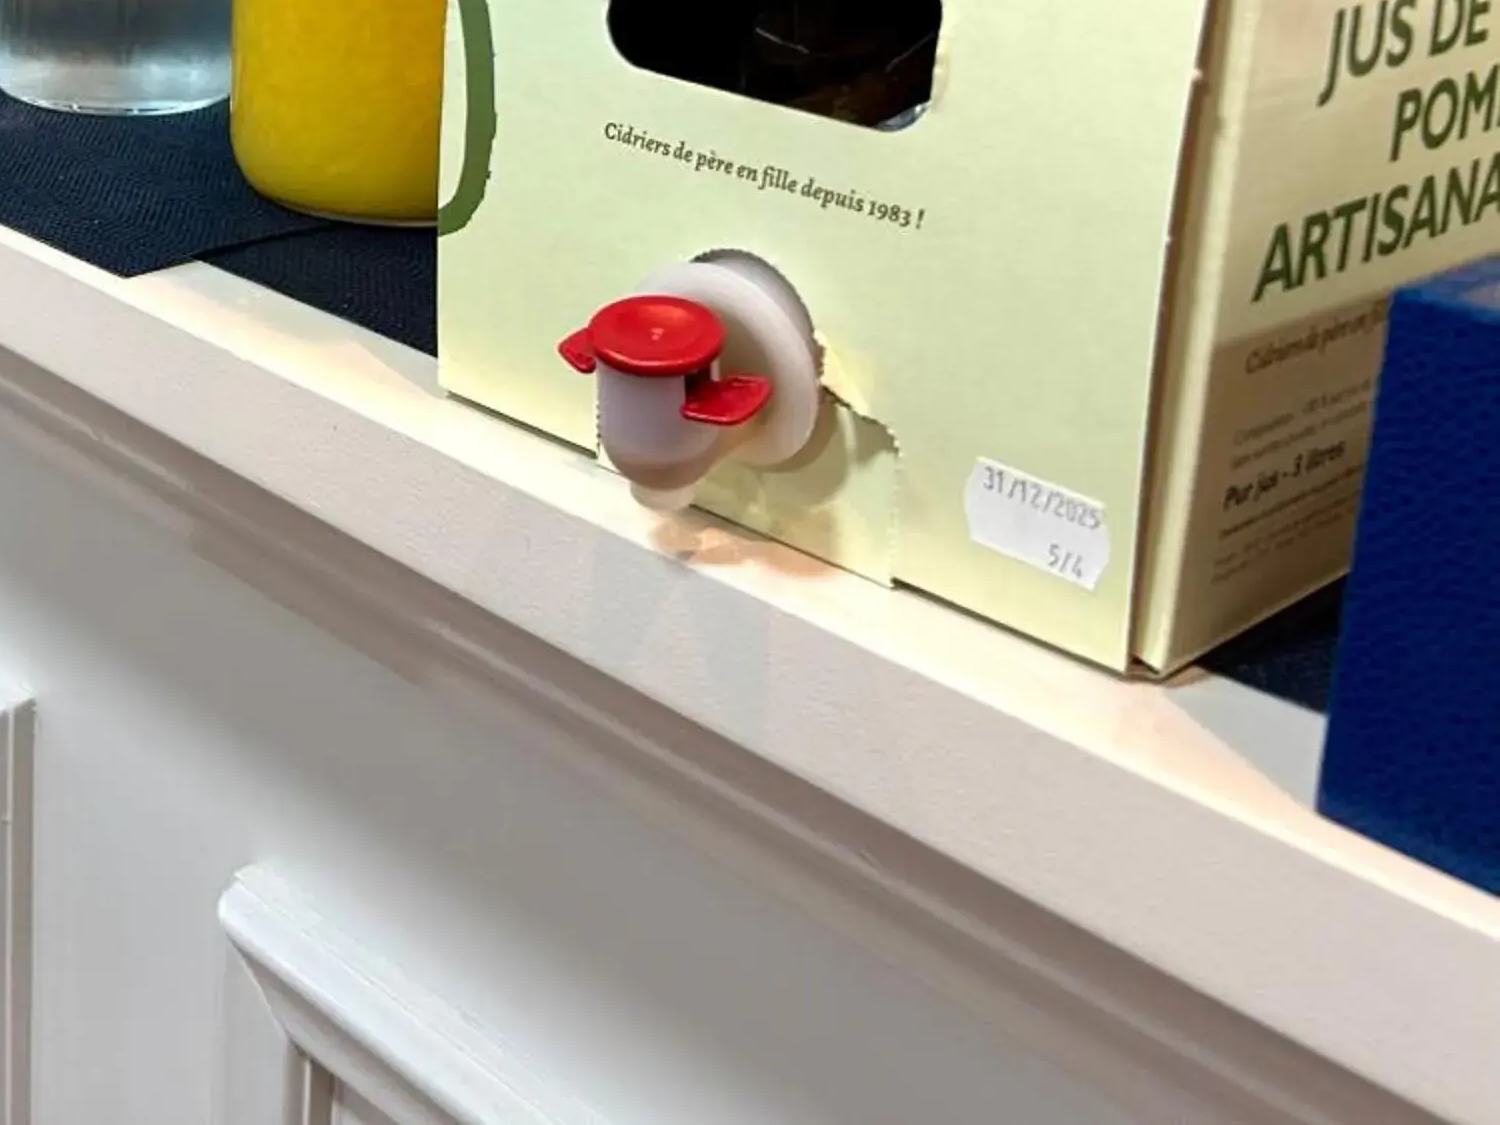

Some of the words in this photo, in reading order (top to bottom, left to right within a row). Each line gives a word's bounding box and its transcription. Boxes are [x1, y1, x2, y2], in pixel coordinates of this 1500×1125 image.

[1389, 63, 1500, 163] POM
[604, 122, 671, 157] Cidriers
[673, 141, 694, 164] de
[695, 149, 735, 175] père
[736, 162, 759, 183] en
[757, 165, 799, 193] fille
[800, 176, 865, 213] depuis
[867, 199, 911, 227] 1983
